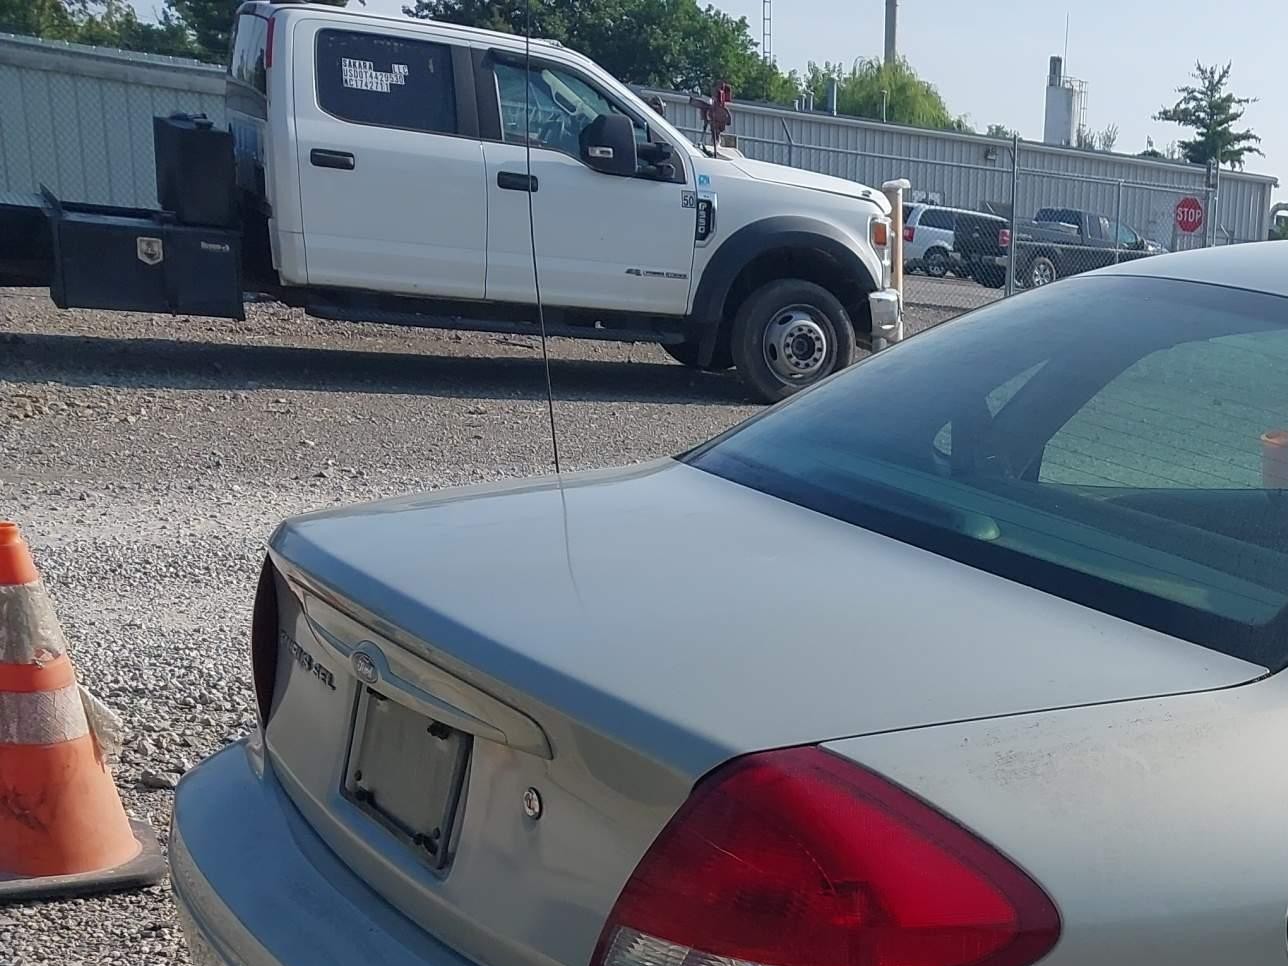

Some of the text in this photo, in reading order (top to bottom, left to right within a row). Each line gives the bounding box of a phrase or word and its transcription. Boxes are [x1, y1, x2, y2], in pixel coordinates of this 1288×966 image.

[392, 64, 409, 75] LLC
[683, 195, 695, 207] 50
[1177, 207, 1202, 223] STOP
